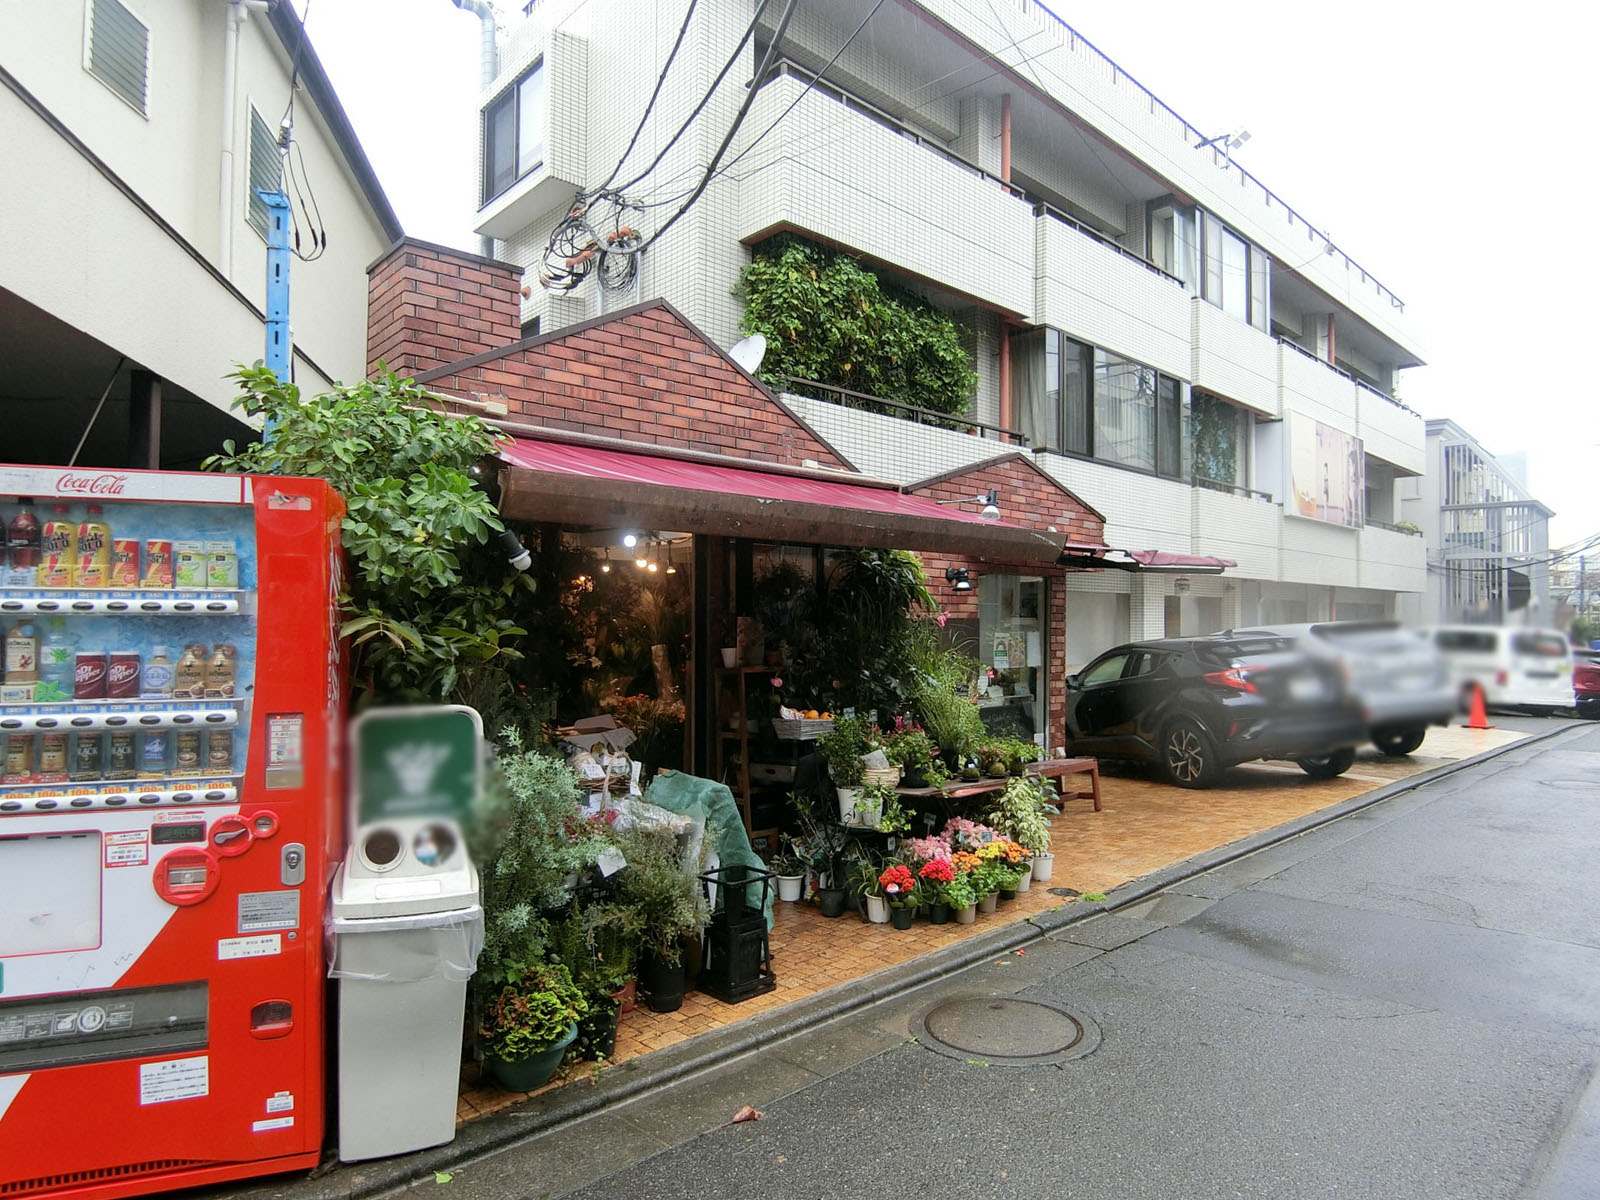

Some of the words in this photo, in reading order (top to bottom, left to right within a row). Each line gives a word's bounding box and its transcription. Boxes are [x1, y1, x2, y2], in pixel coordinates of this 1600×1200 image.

[56, 473, 128, 494] Coca-Cola
[81, 665, 93, 674] Dr
[115, 665, 126, 674] Dr
